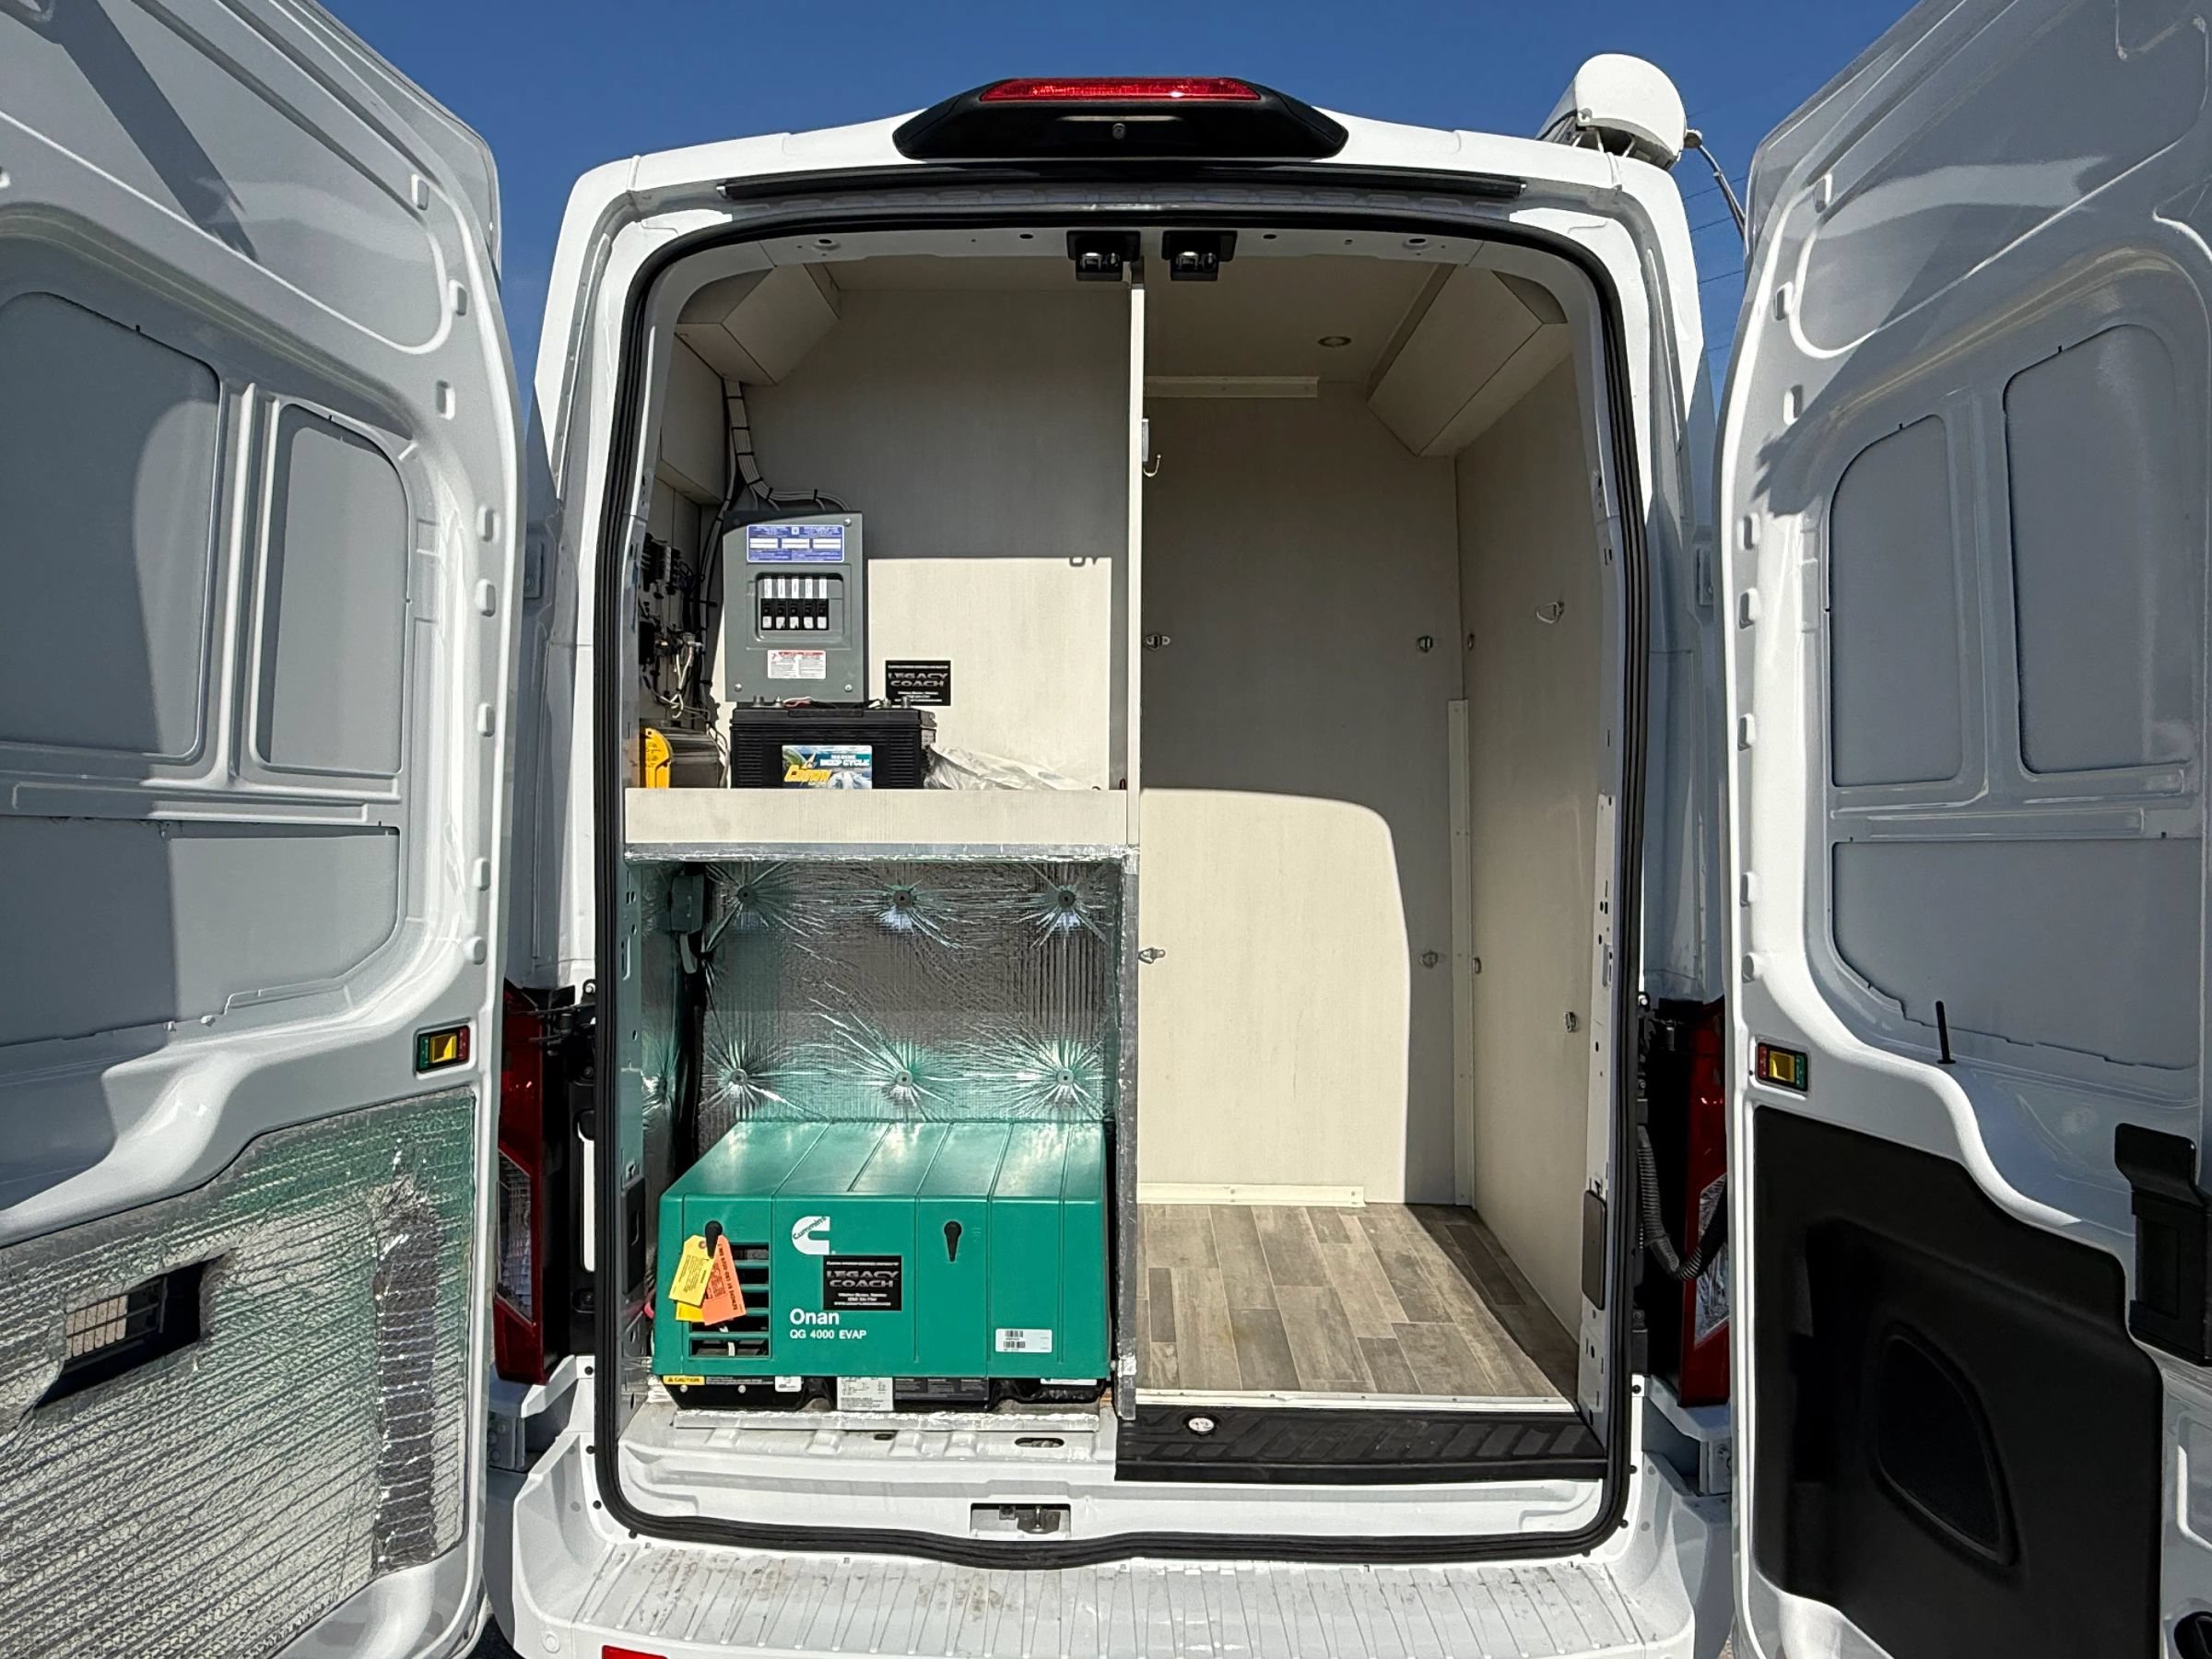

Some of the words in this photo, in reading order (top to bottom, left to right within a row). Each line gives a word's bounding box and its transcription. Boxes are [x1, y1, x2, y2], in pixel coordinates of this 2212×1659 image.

[842, 759, 870, 767] CYCLE
[793, 1216, 828, 1240] Cummins
[827, 1270, 899, 1278] LEGACY
[830, 1279, 893, 1288] COACH
[790, 1308, 840, 1325] Onan
[790, 1329, 806, 1339] QG
[810, 1329, 835, 1339] 4000
[839, 1329, 867, 1339] EVAP
